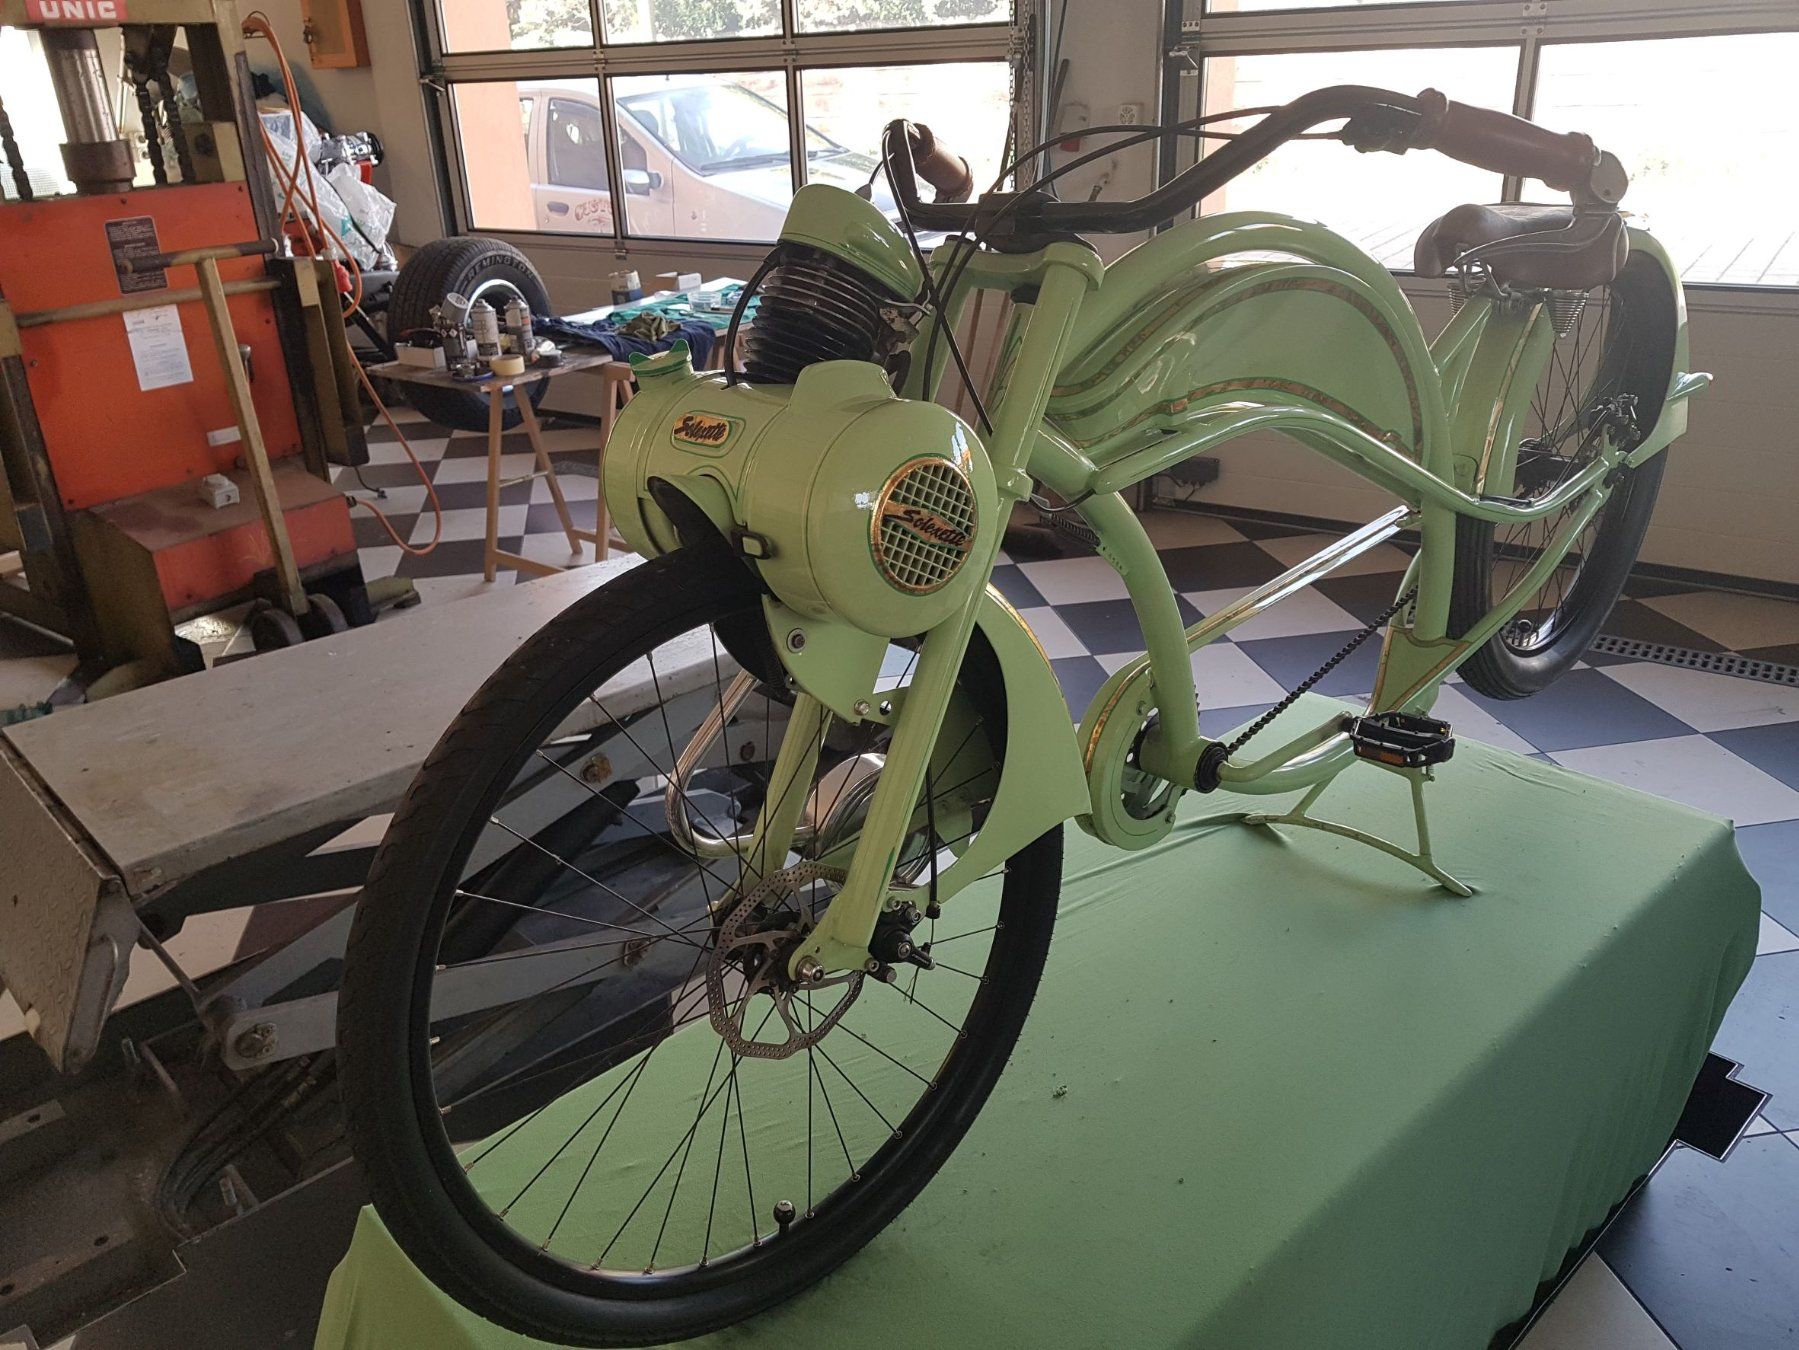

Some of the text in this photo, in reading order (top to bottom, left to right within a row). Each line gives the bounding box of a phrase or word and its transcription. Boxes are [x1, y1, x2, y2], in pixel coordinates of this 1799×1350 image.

[39, 0, 117, 19] UNIC
[467, 255, 535, 281] REMINGTON
[674, 415, 727, 442] Solexette
[883, 509, 966, 547] Solexette
